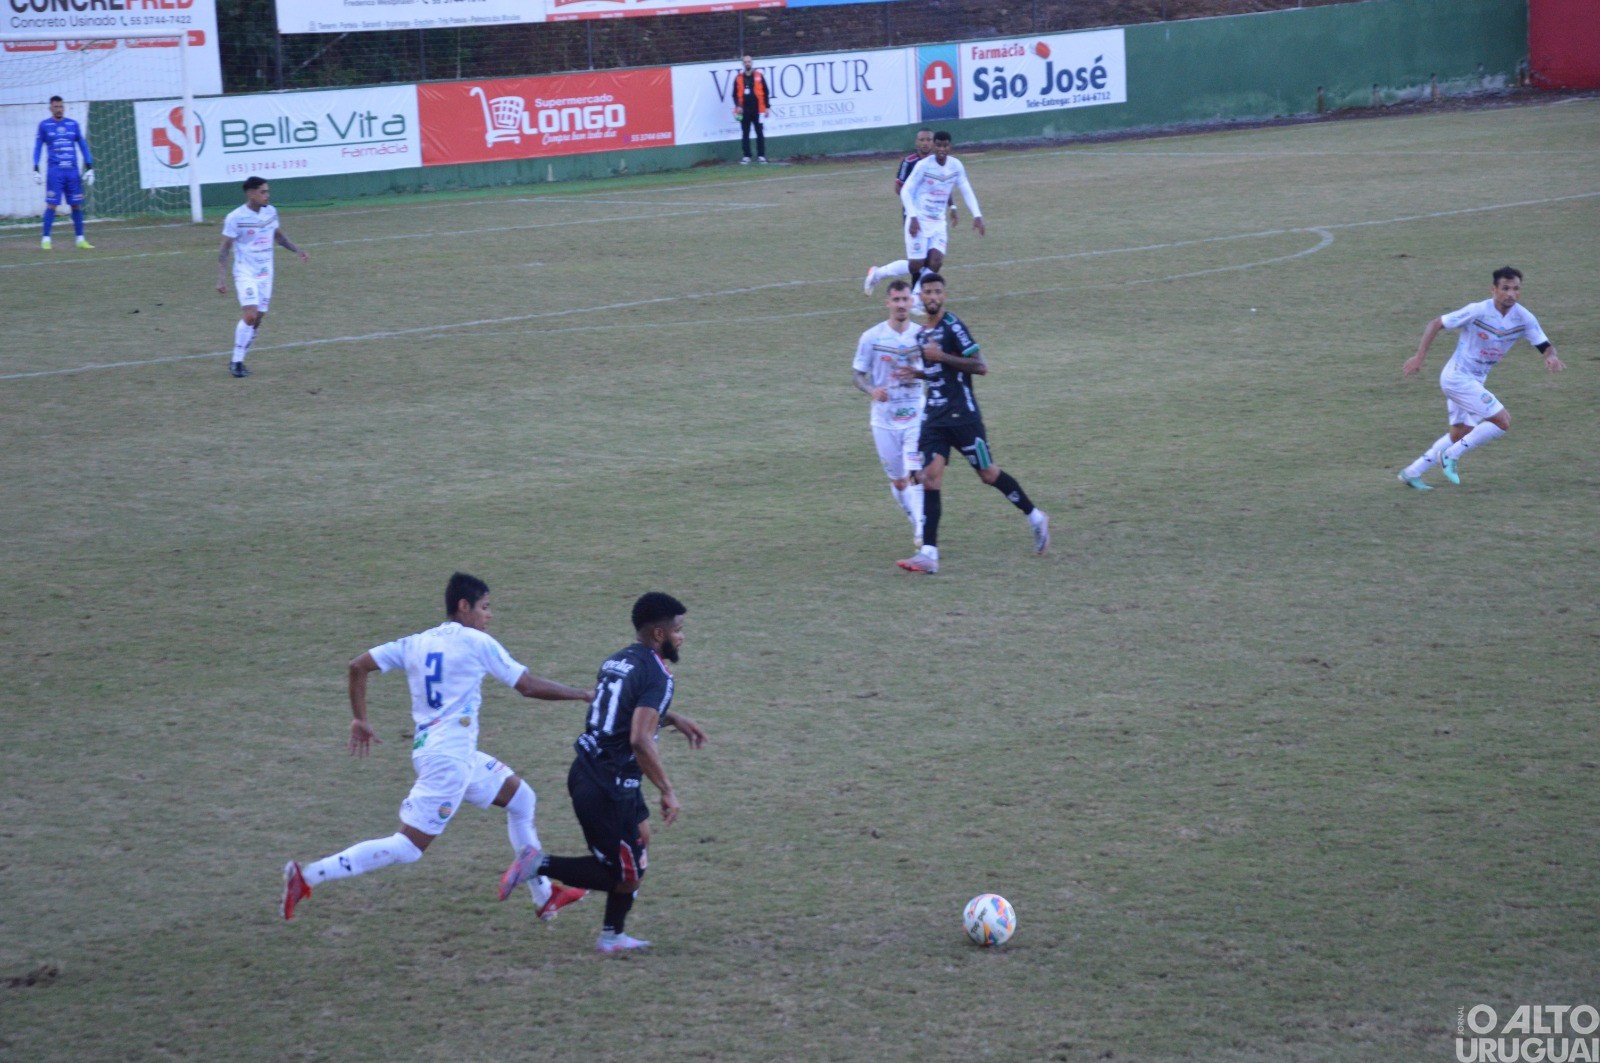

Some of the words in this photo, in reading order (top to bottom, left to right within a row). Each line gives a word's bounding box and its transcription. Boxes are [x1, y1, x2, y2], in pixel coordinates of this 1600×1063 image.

[10, 16, 66, 28] Concreto
[69, 14, 116, 27] Usinado
[973, 66, 1028, 102] São
[1039, 54, 1107, 95] José
[534, 93, 614, 108] Supermercado
[800, 101, 855, 116] TURISMO
[220, 116, 318, 148] Bella
[326, 110, 406, 140] Vita
[425, 652, 443, 711] 2
